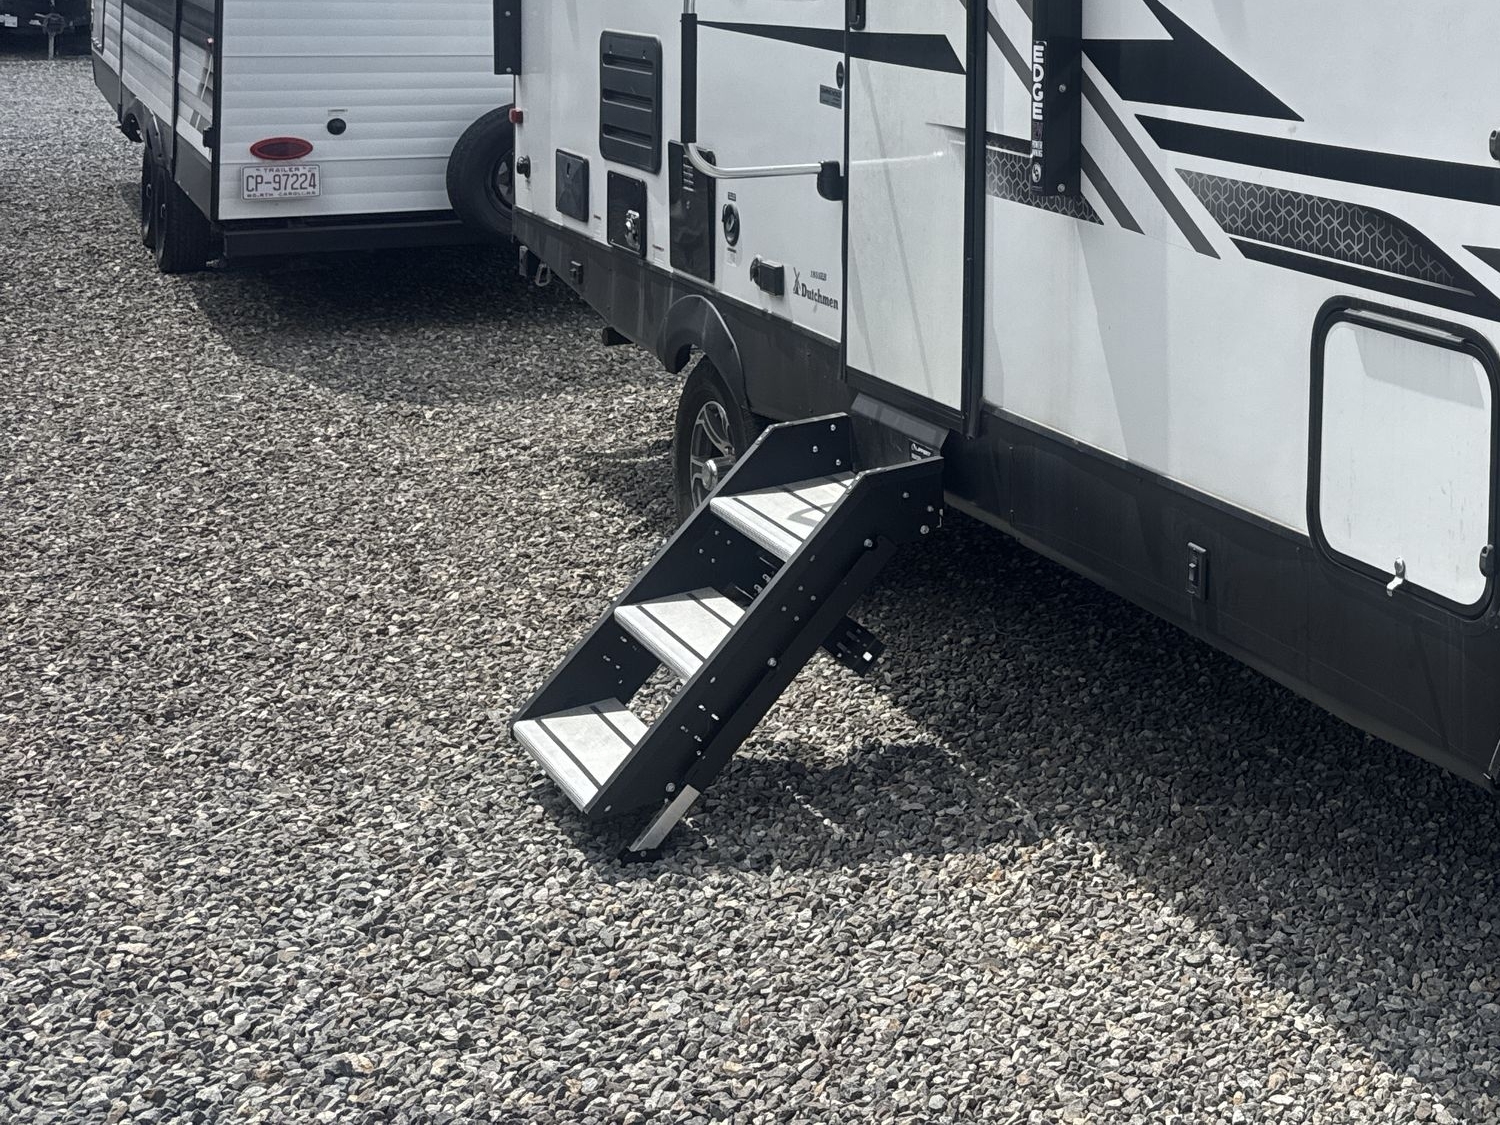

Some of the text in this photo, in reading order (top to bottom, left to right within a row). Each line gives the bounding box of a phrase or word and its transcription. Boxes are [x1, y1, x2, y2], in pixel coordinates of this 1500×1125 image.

[1031, 44, 1045, 121] EDGE
[246, 172, 317, 193] CP-97224
[801, 282, 839, 310] Dutchmen
